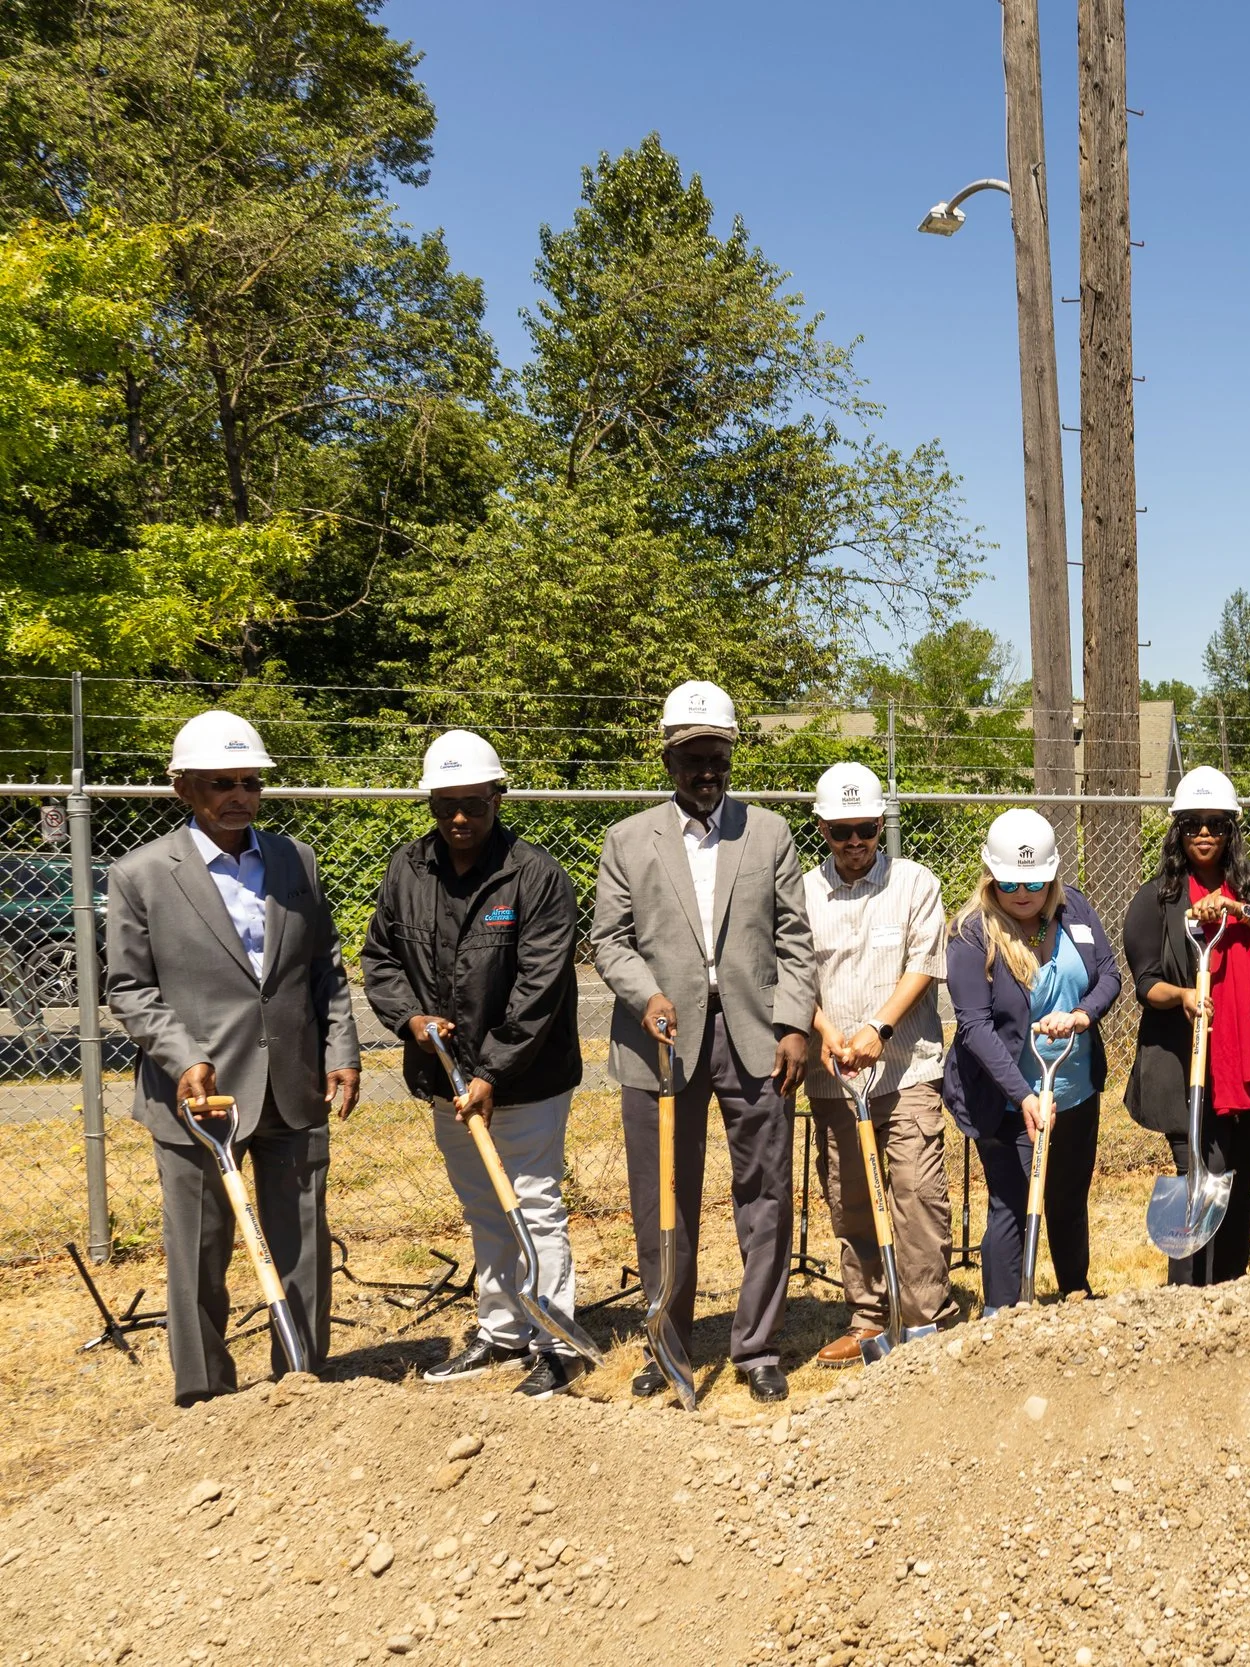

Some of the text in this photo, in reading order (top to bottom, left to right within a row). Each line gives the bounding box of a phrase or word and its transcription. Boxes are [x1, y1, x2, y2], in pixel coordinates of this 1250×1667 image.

[870, 1153, 885, 1212] African Community
[1033, 1155, 1042, 1178] African
[245, 1202, 272, 1264] African Community
